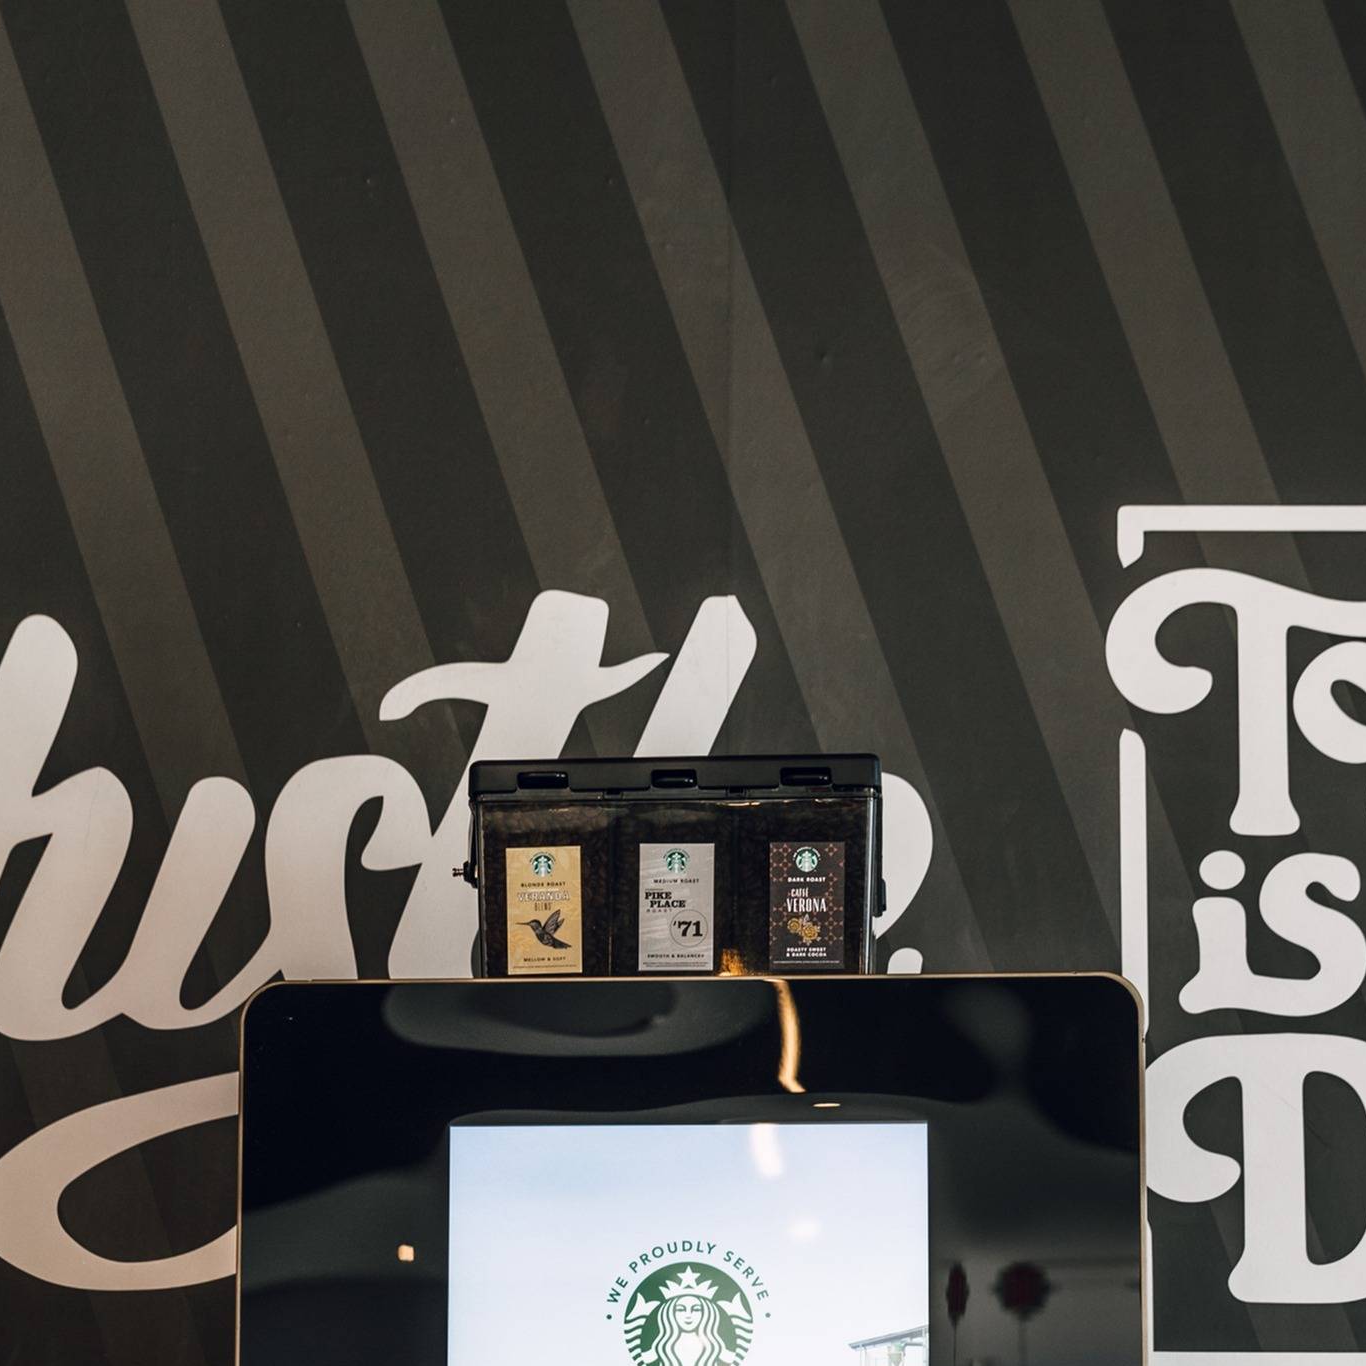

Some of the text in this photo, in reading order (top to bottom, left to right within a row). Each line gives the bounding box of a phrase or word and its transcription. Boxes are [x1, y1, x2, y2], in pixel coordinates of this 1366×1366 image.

[517, 890, 570, 902] VERANDA
[645, 891, 672, 900] PIKE
[650, 900, 686, 908] PLACE
[786, 898, 827, 912] VERONA
[606, 1240, 769, 1304] WE PROUDLY SERVE
